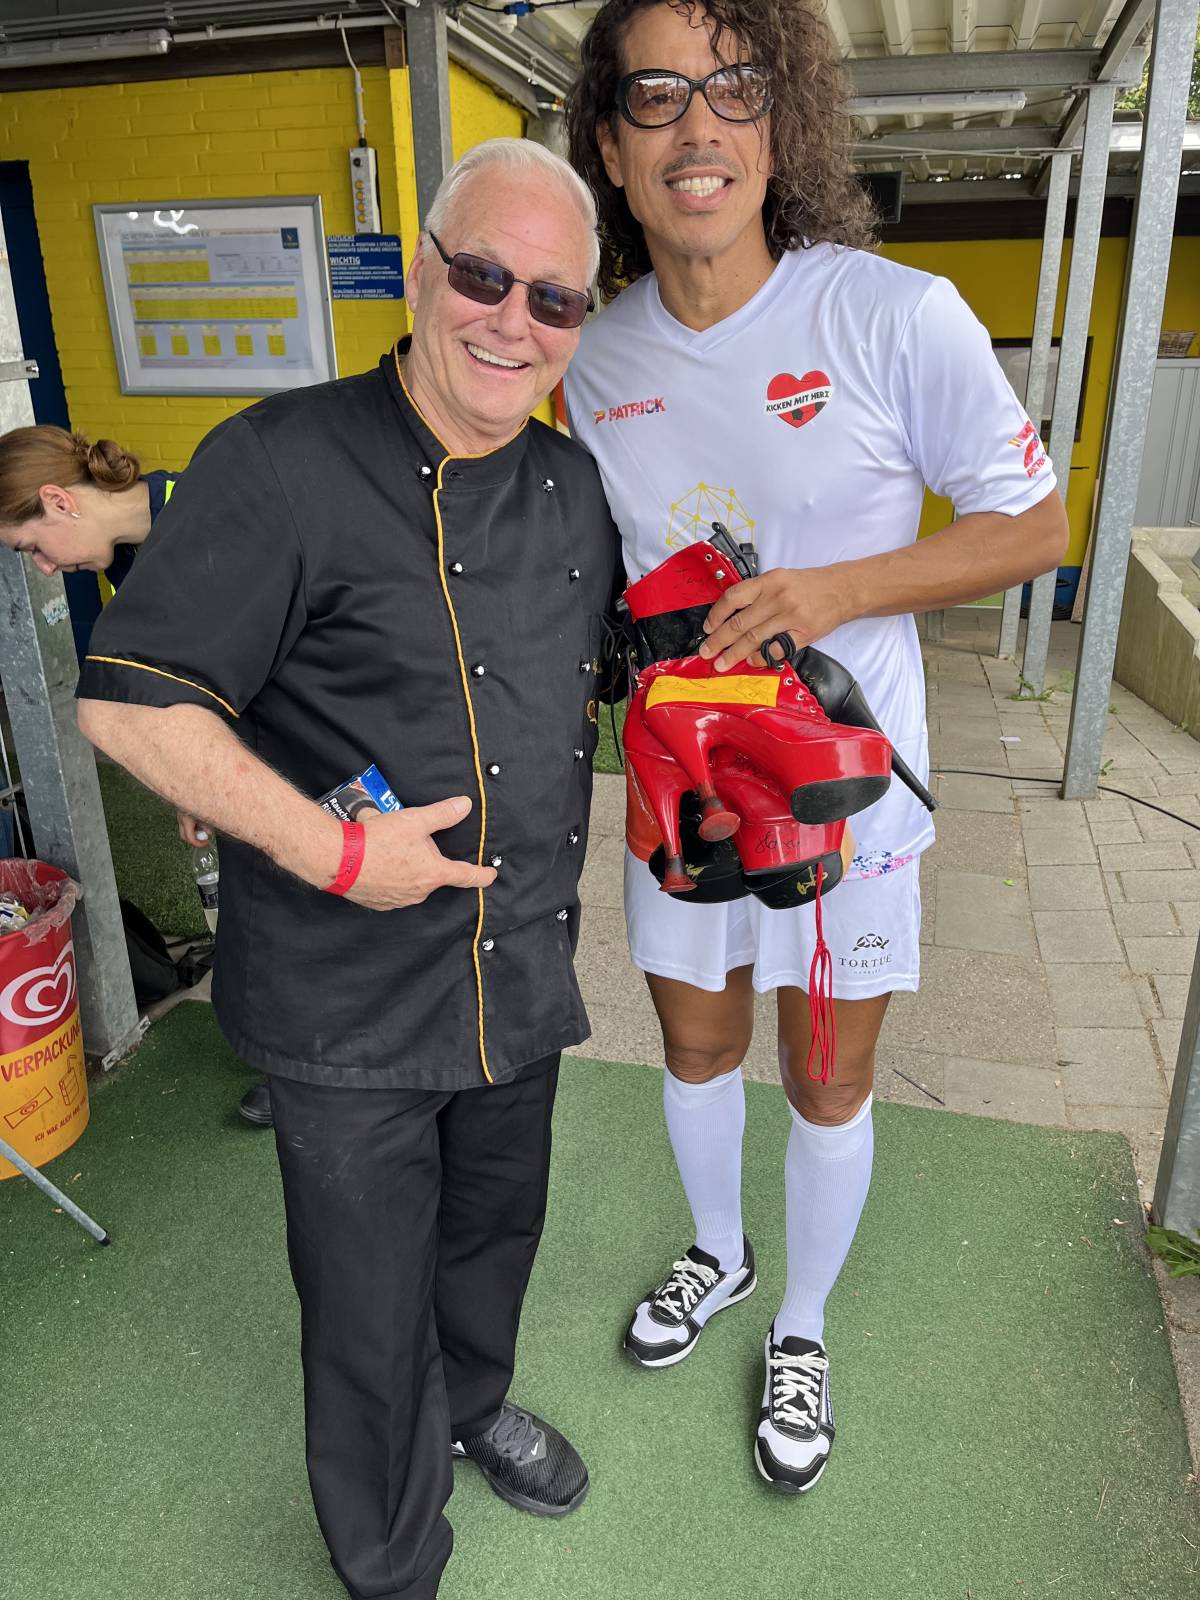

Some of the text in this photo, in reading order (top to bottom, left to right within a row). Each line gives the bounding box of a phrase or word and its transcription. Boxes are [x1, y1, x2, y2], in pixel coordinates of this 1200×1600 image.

[330, 257, 361, 265] WICHTIG
[608, 396, 667, 422] PATRICK
[766, 390, 830, 412] KICKEN MIT HERZ
[838, 953, 894, 968] TORTUE
[1, 1014, 80, 1083] VERPACKUN
[34, 1131, 45, 1143] ICH
[46, 1123, 58, 1136] WAR
